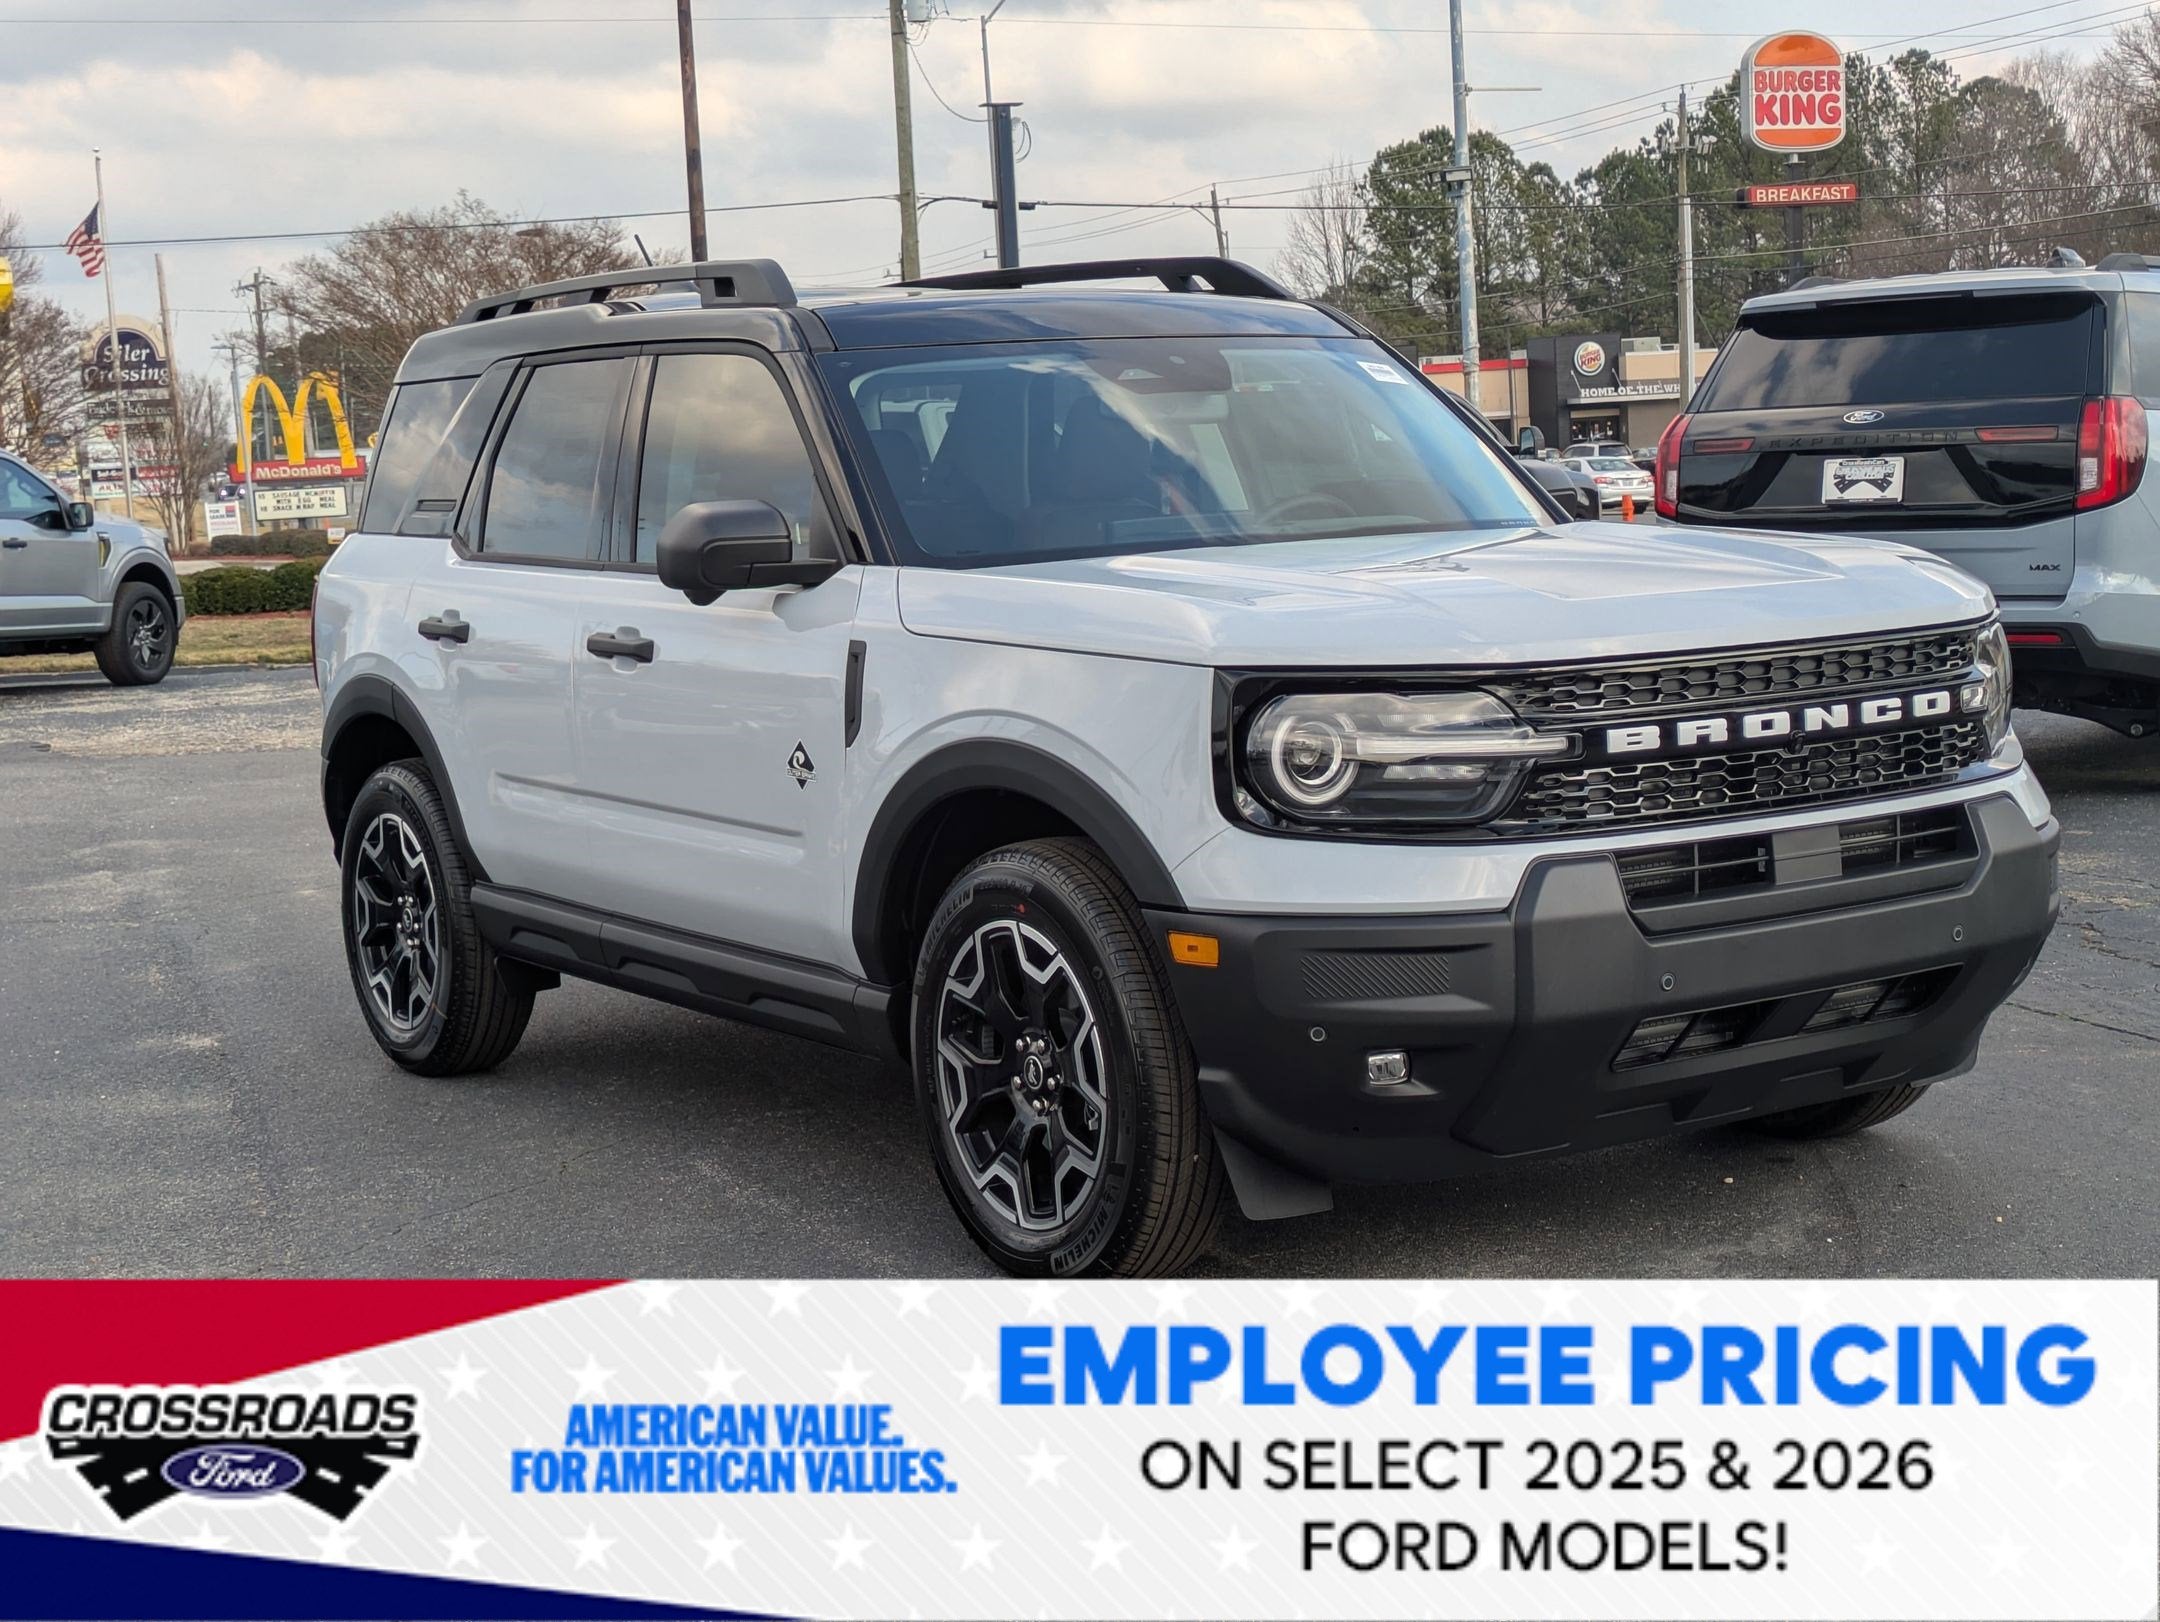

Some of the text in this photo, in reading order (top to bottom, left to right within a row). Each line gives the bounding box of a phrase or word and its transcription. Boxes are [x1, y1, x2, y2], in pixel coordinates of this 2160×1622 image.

[1754, 70, 1841, 93] BURGER
[1754, 93, 1841, 126] KING
[1756, 186, 1850, 203] BREAKFAST
[1580, 354, 1601, 368] KING
[1580, 387, 1615, 397] HOME
[1618, 385, 1636, 396] OF
[1636, 384, 1663, 395] THE
[1769, 432, 1958, 448] EXPEDITION
[256, 463, 342, 479] McDonald's
[272, 491, 300, 499] SAUSAGE
[1606, 691, 1951, 753] BRONCO
[1053, 1205, 1110, 1271] MICHELIN
